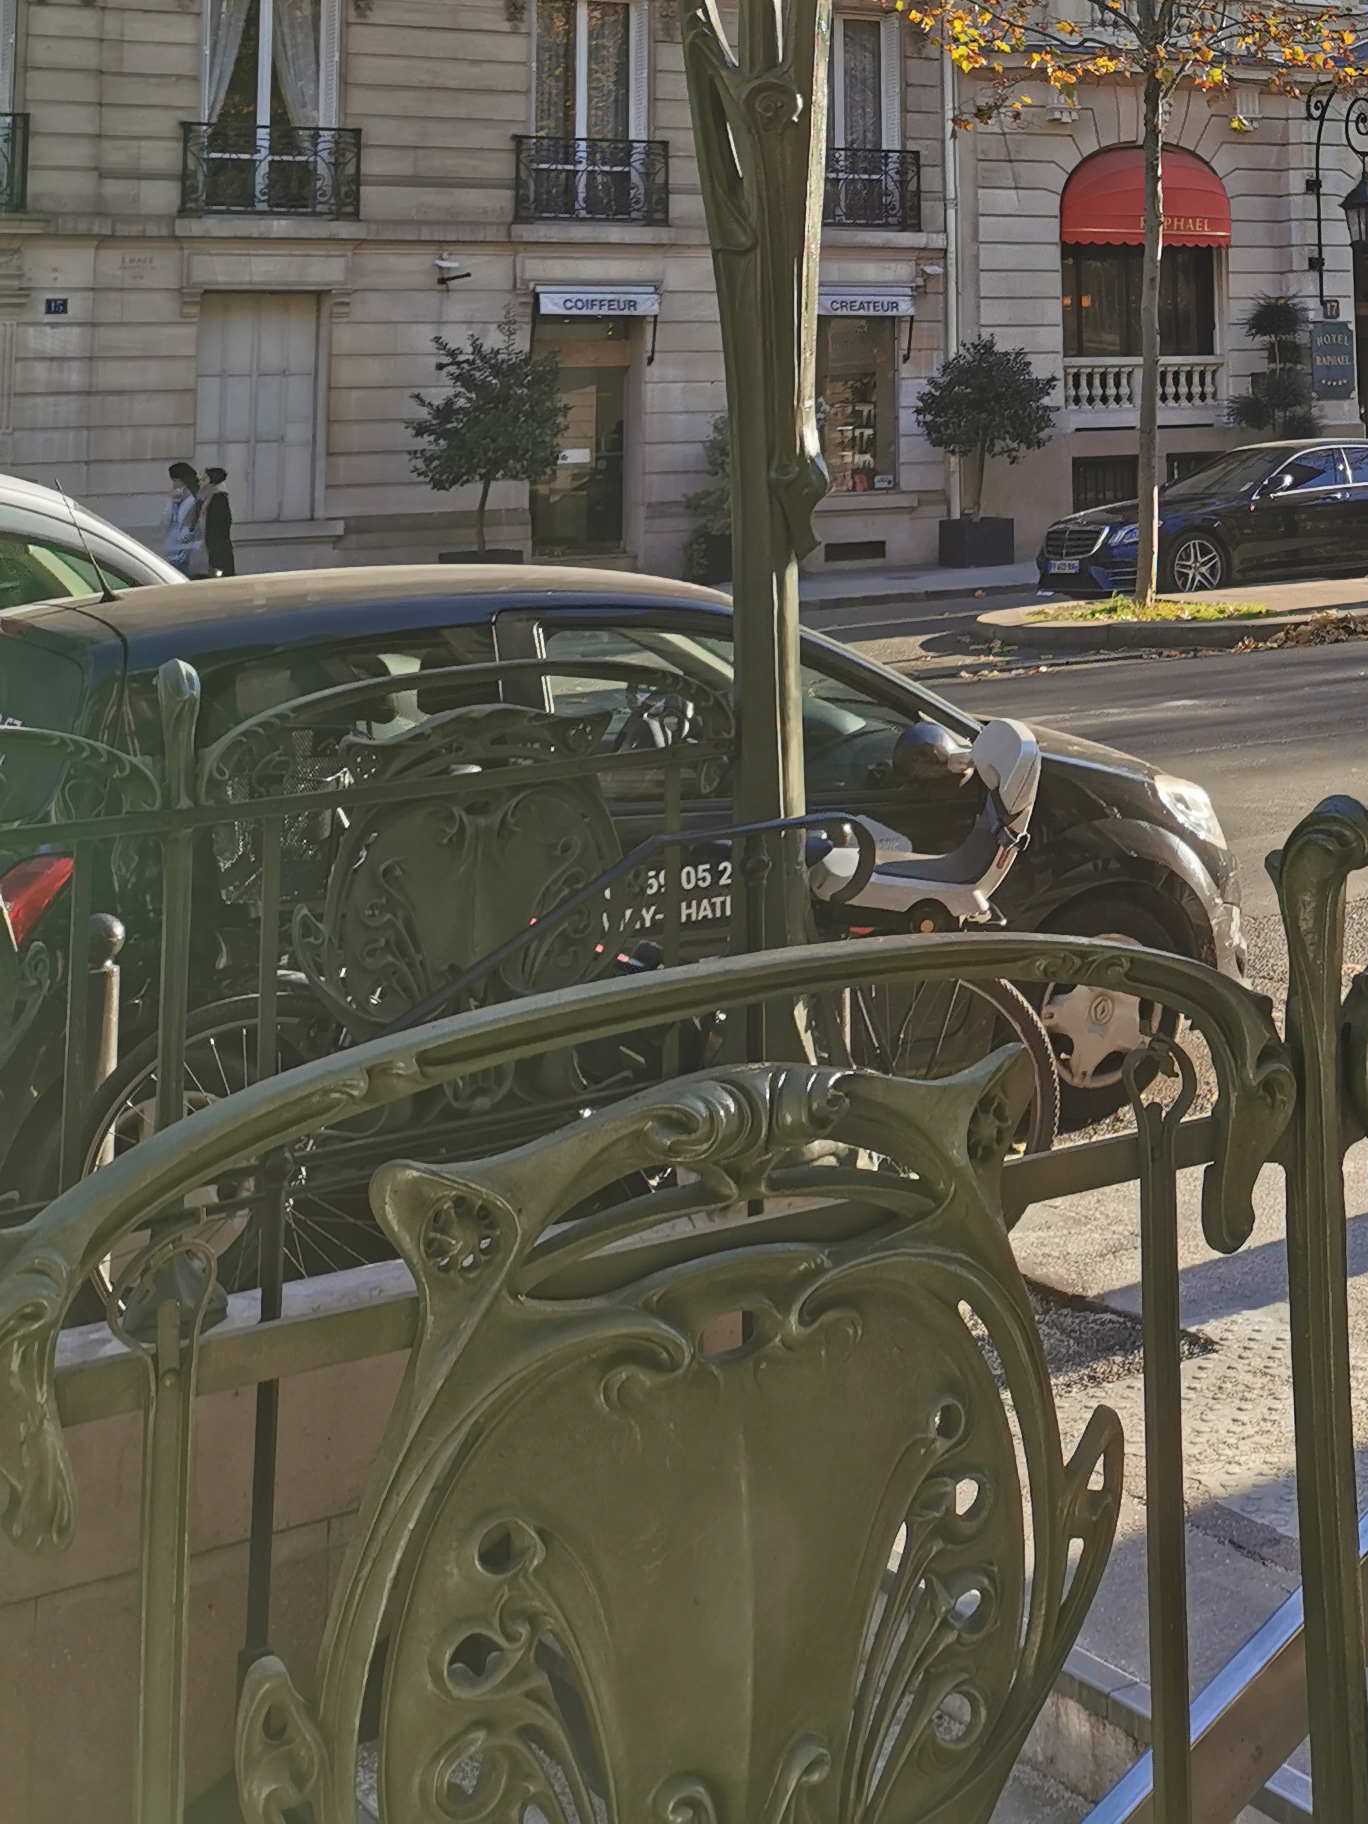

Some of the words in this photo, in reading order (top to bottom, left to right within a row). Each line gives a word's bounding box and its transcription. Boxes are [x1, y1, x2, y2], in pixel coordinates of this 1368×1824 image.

[1140, 217, 1211, 232] RPHAEL
[563, 298, 638, 312] COIFFEUR
[830, 300, 900, 313] CREATEUR
[1325, 302, 1338, 317] 17
[1316, 355, 1351, 366] RAPHAEL
[681, 863, 712, 890] 05
